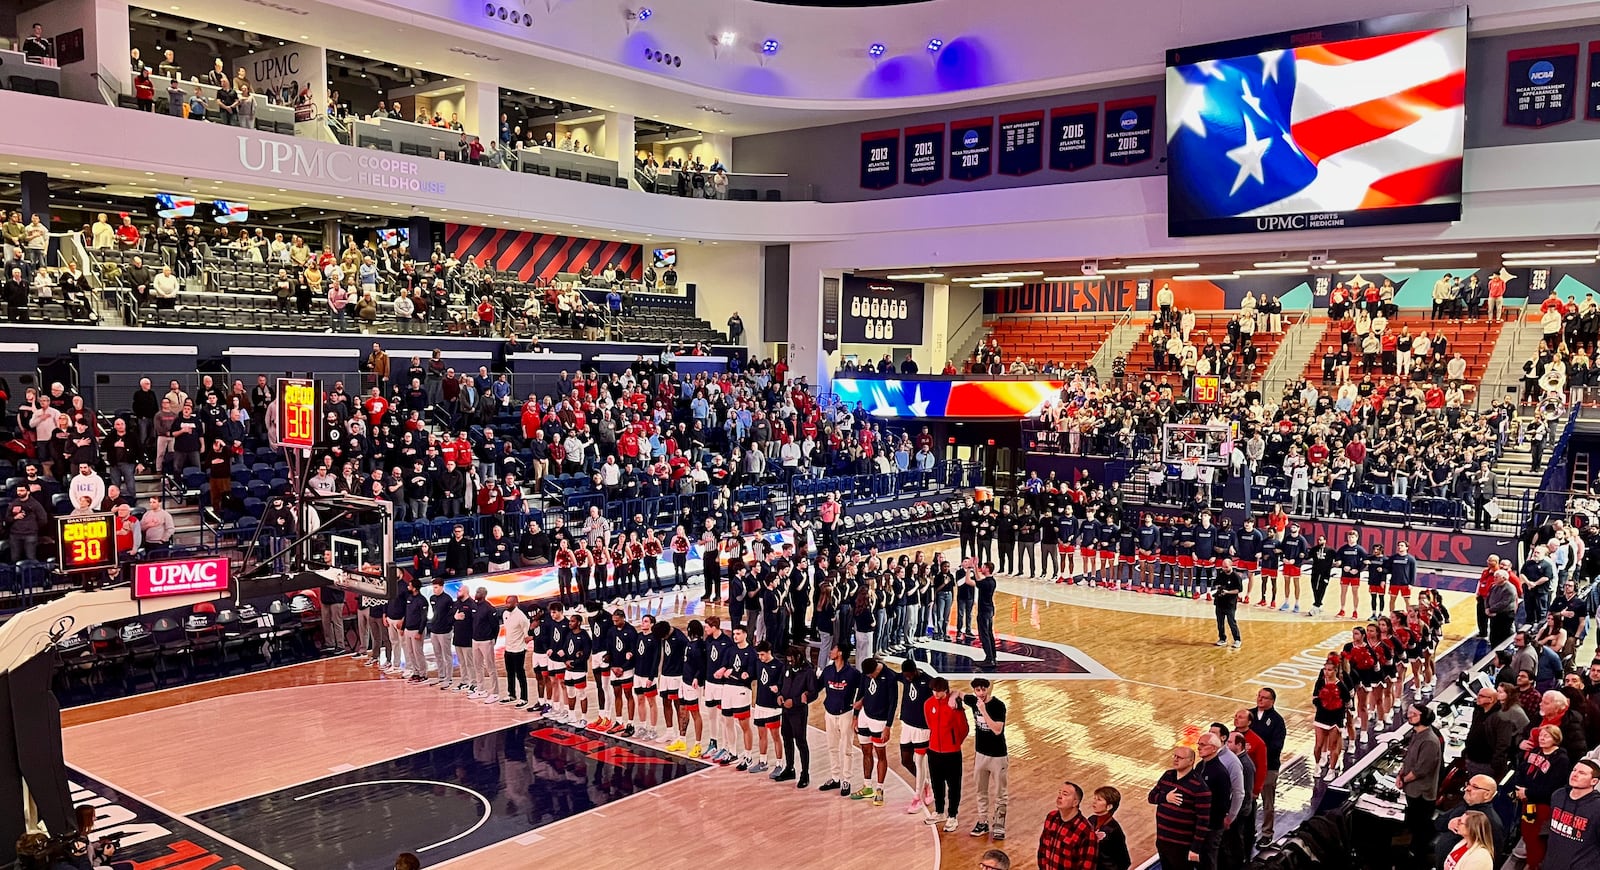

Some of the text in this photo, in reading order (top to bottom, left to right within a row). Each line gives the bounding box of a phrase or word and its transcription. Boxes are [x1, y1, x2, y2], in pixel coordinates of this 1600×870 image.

[254, 52, 299, 82] UPMC
[1530, 71, 1554, 80] NCAA
[1063, 124, 1084, 140] 2016
[1119, 129, 1150, 138] TOURNAMENT
[915, 142, 933, 156] 2013
[1118, 137, 1138, 150] 2016
[236, 136, 353, 183] UPMC
[871, 147, 888, 161] 2013
[962, 154, 979, 167] 2013
[358, 156, 418, 176] COOPER
[358, 172, 446, 194] FIELDHOUSE
[1256, 215, 1305, 231] UPMC
[1309, 219, 1345, 228] MEDICINE
[1310, 213, 1338, 221] SPORTS
[1198, 386, 1215, 400] 30
[289, 405, 310, 439] 30
[1224, 501, 1246, 510] UPMC
[64, 521, 108, 541] 20:00
[73, 539, 101, 562] 30
[148, 561, 218, 586] UPMC
